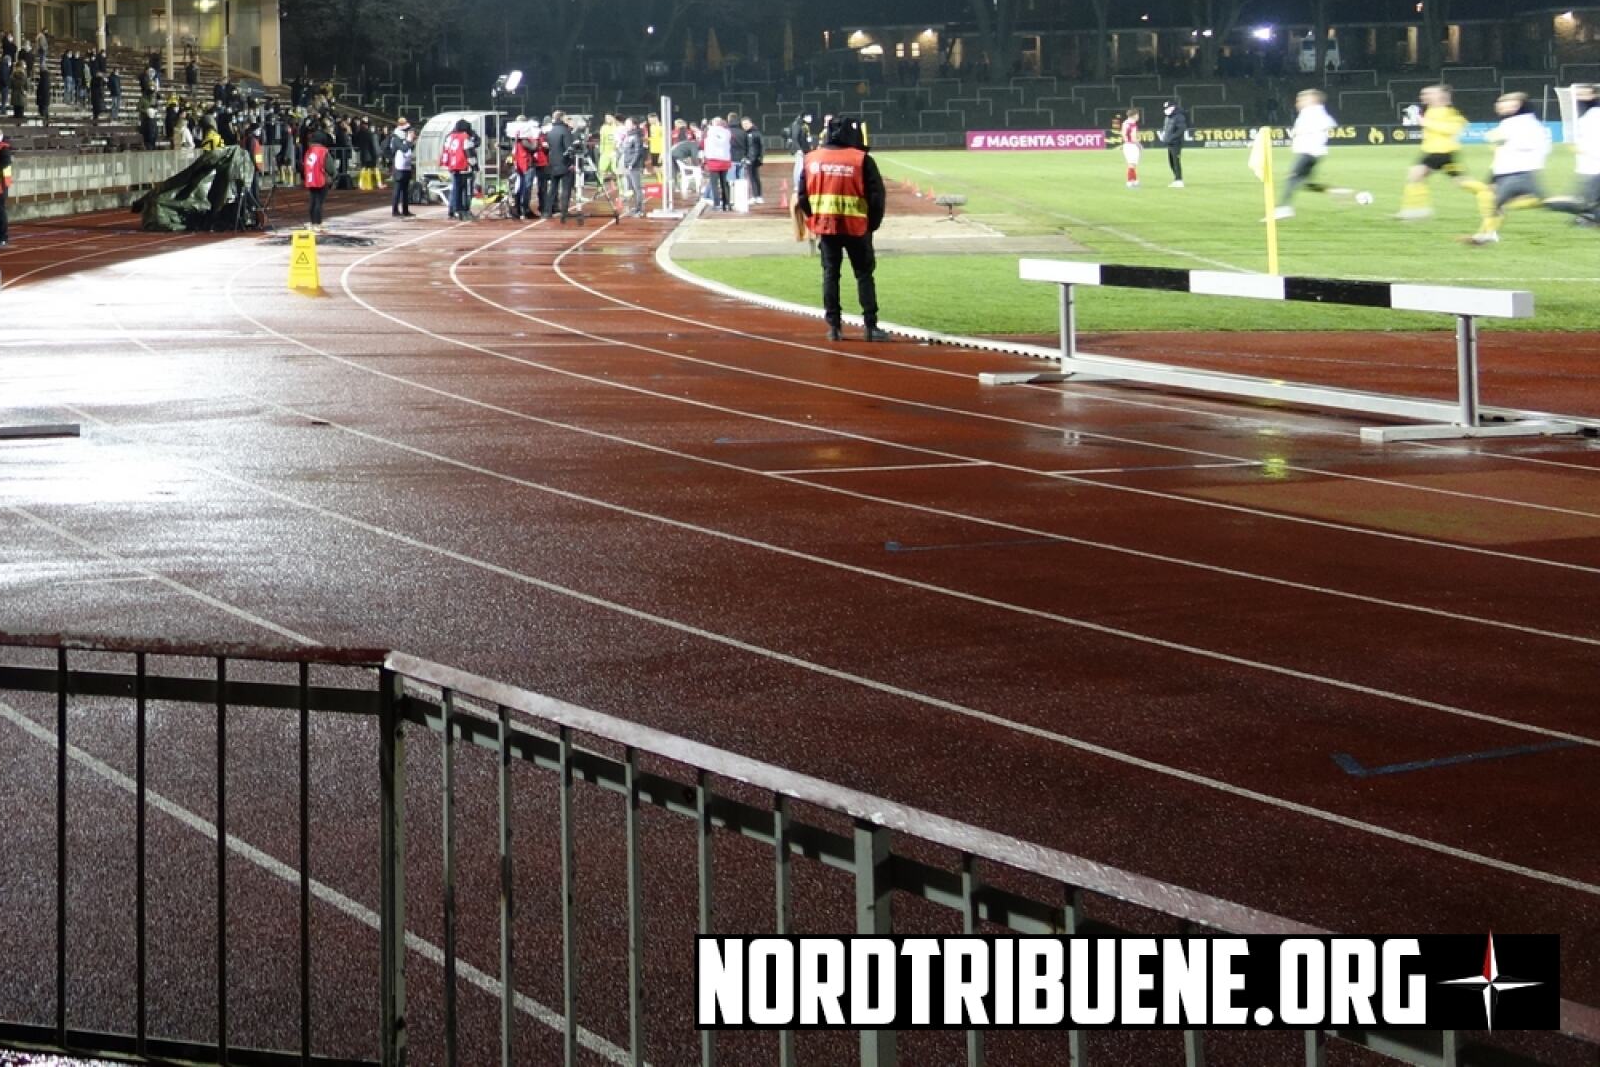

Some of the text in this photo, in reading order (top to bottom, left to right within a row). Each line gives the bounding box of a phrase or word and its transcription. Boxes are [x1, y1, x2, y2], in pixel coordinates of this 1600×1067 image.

[987, 133, 1101, 147] MAGENTA SPORT
[1194, 128, 1247, 141] STROM
[1327, 126, 1357, 138] GAS
